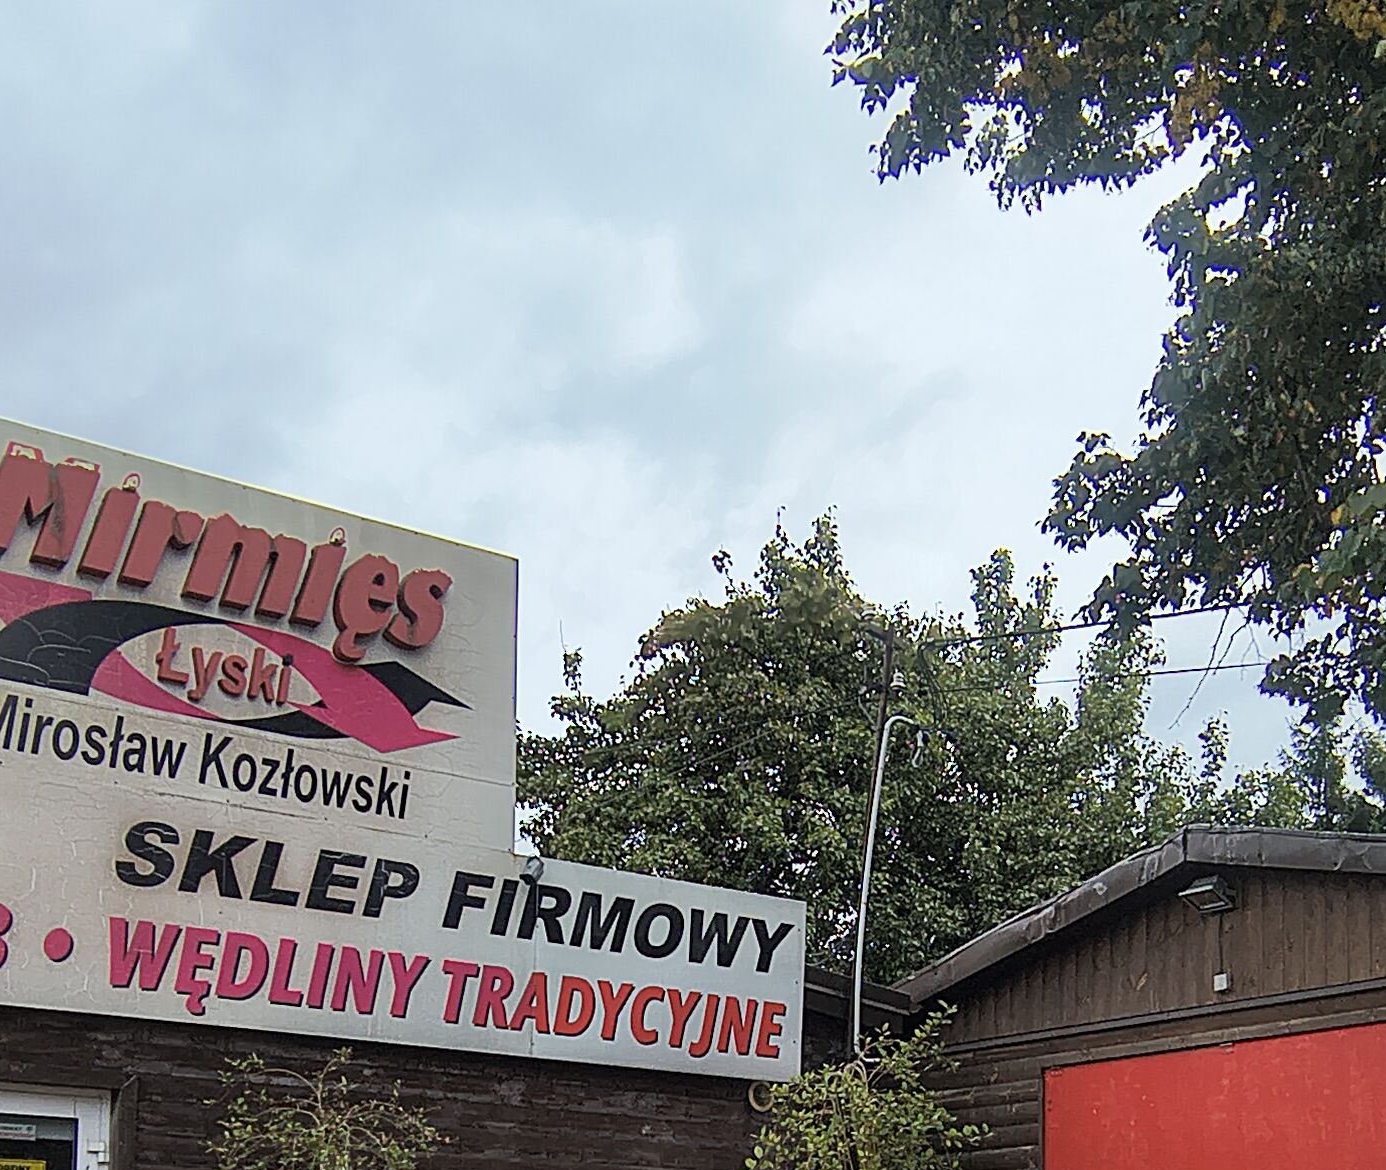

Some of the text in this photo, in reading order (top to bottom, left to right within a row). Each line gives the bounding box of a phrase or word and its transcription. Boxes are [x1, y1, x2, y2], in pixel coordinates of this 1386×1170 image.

[154, 625, 294, 707] Łyski
[198, 732, 412, 820] Kozłowski
[115, 820, 796, 974] SKLEP FIRMOWY
[108, 916, 788, 1059] WĘDLINY TRADYCYJNE
